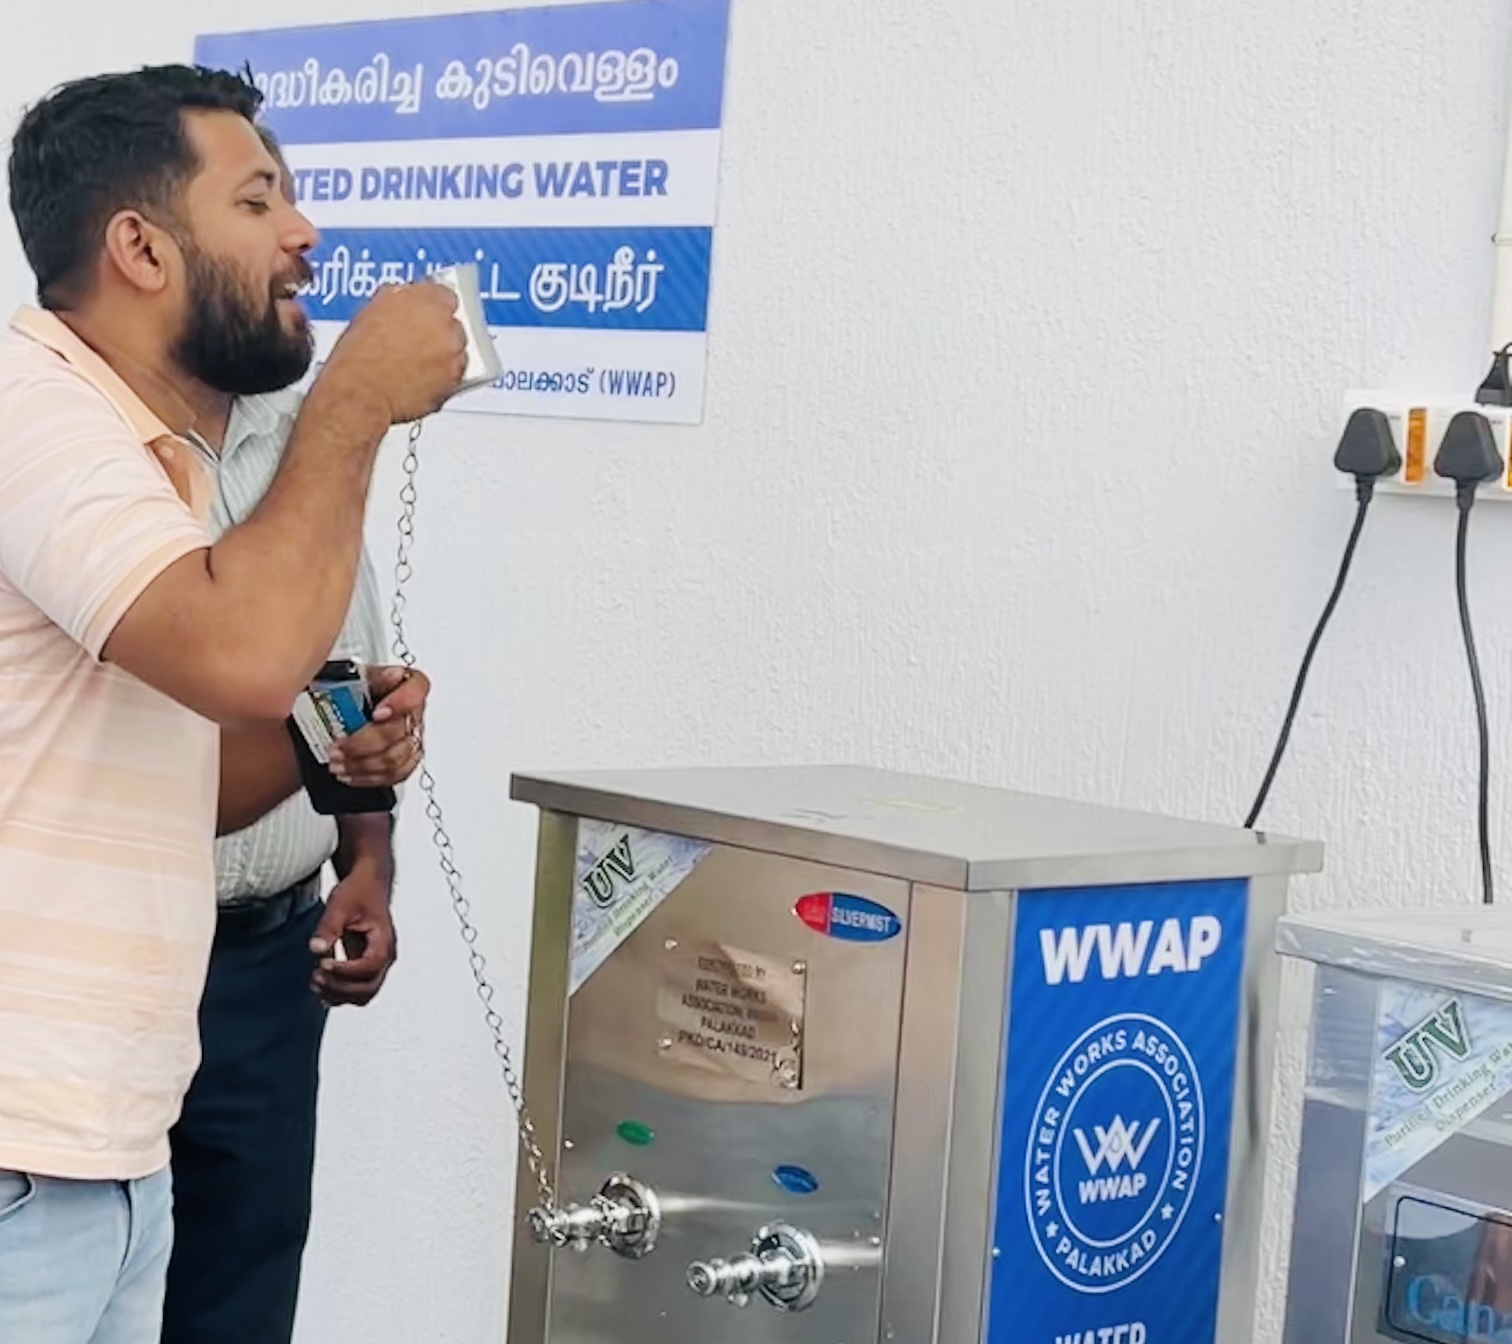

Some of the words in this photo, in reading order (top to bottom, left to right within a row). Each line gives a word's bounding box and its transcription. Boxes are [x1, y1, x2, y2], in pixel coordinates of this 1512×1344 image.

[254, 52, 424, 120] ദ്ധീകരിച്ച
[435, 42, 679, 110] കുടിവെള്ളം
[294, 167, 353, 202] TED
[361, 163, 524, 201] DRINKING
[533, 159, 668, 198] WATER
[529, 245, 664, 313] குடிநீர்
[600, 369, 676, 398] (WWAP)
[581, 833, 638, 909] UV
[1040, 915, 1221, 986] WWAP
[1382, 996, 1472, 1092] UV
[1433, 1064, 1490, 1108] Drinking
[1035, 1106, 1061, 1216] WATER
[1055, 1029, 1127, 1097] WORKS
[1132, 1030, 1195, 1191] ASSOCIATION
[1078, 1172, 1148, 1205] WWAP
[1055, 1228, 1157, 1277] PALAKKAD
